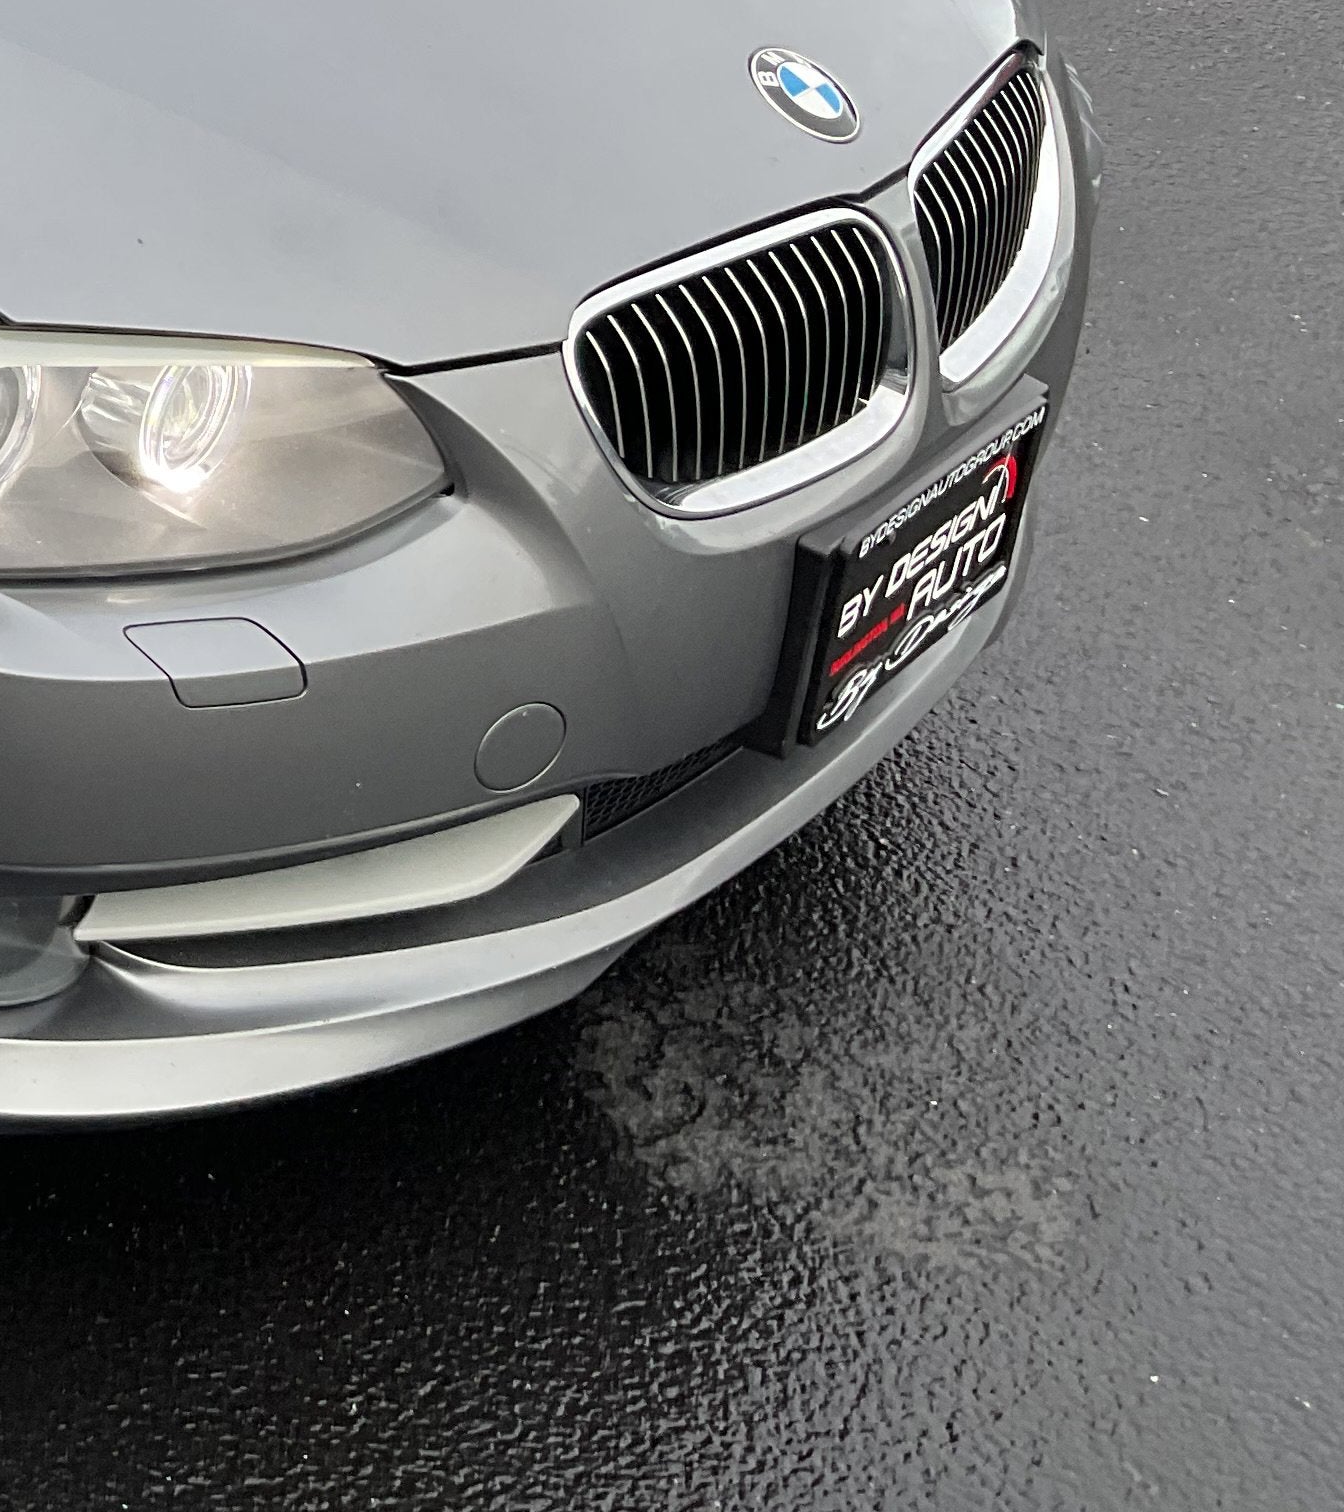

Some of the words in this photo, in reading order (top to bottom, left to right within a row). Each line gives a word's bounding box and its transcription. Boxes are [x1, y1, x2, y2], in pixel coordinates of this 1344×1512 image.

[838, 574, 884, 638] BY
[884, 480, 1004, 599] DESIGN
[907, 512, 1007, 621] AUTO
[816, 662, 885, 731] By
[884, 564, 1008, 671] Design
